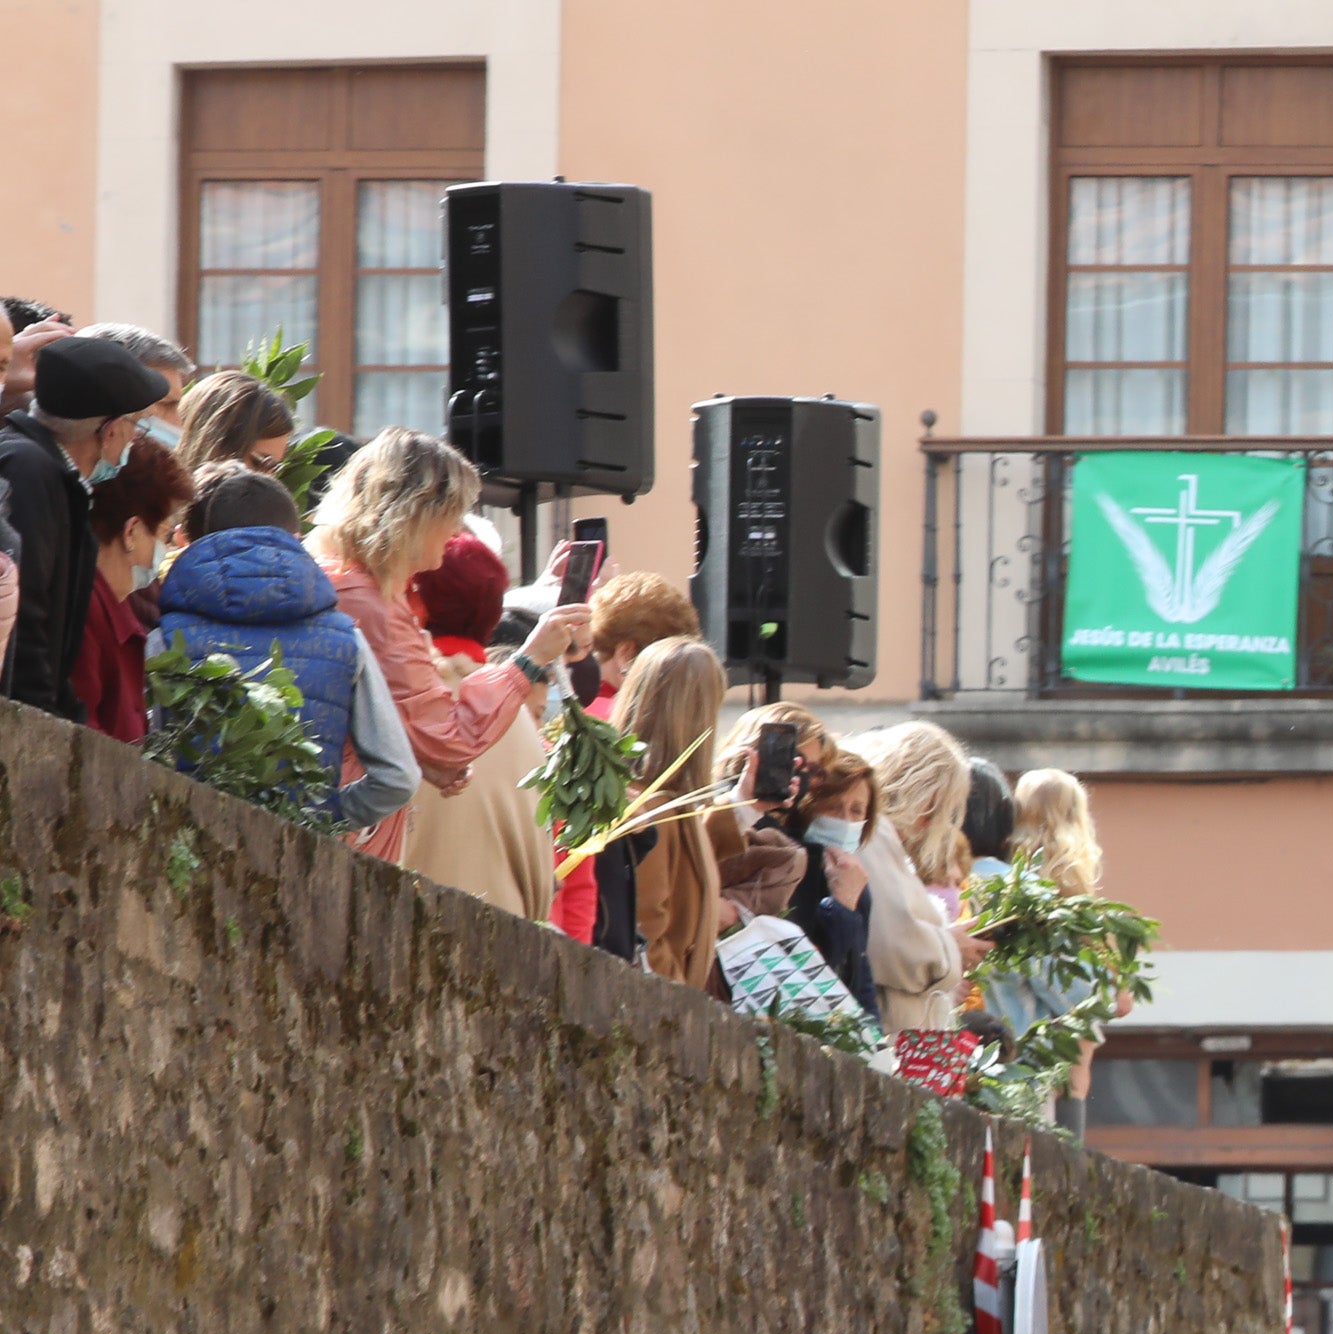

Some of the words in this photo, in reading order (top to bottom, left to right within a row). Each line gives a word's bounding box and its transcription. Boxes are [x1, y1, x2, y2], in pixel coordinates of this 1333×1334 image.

[1071, 626, 1125, 646] JESÚS
[1130, 633, 1152, 646] DE
[1157, 634, 1181, 647] LA
[1186, 635, 1289, 653] ESPERANZA
[1149, 655, 1210, 673] AVILÉS
